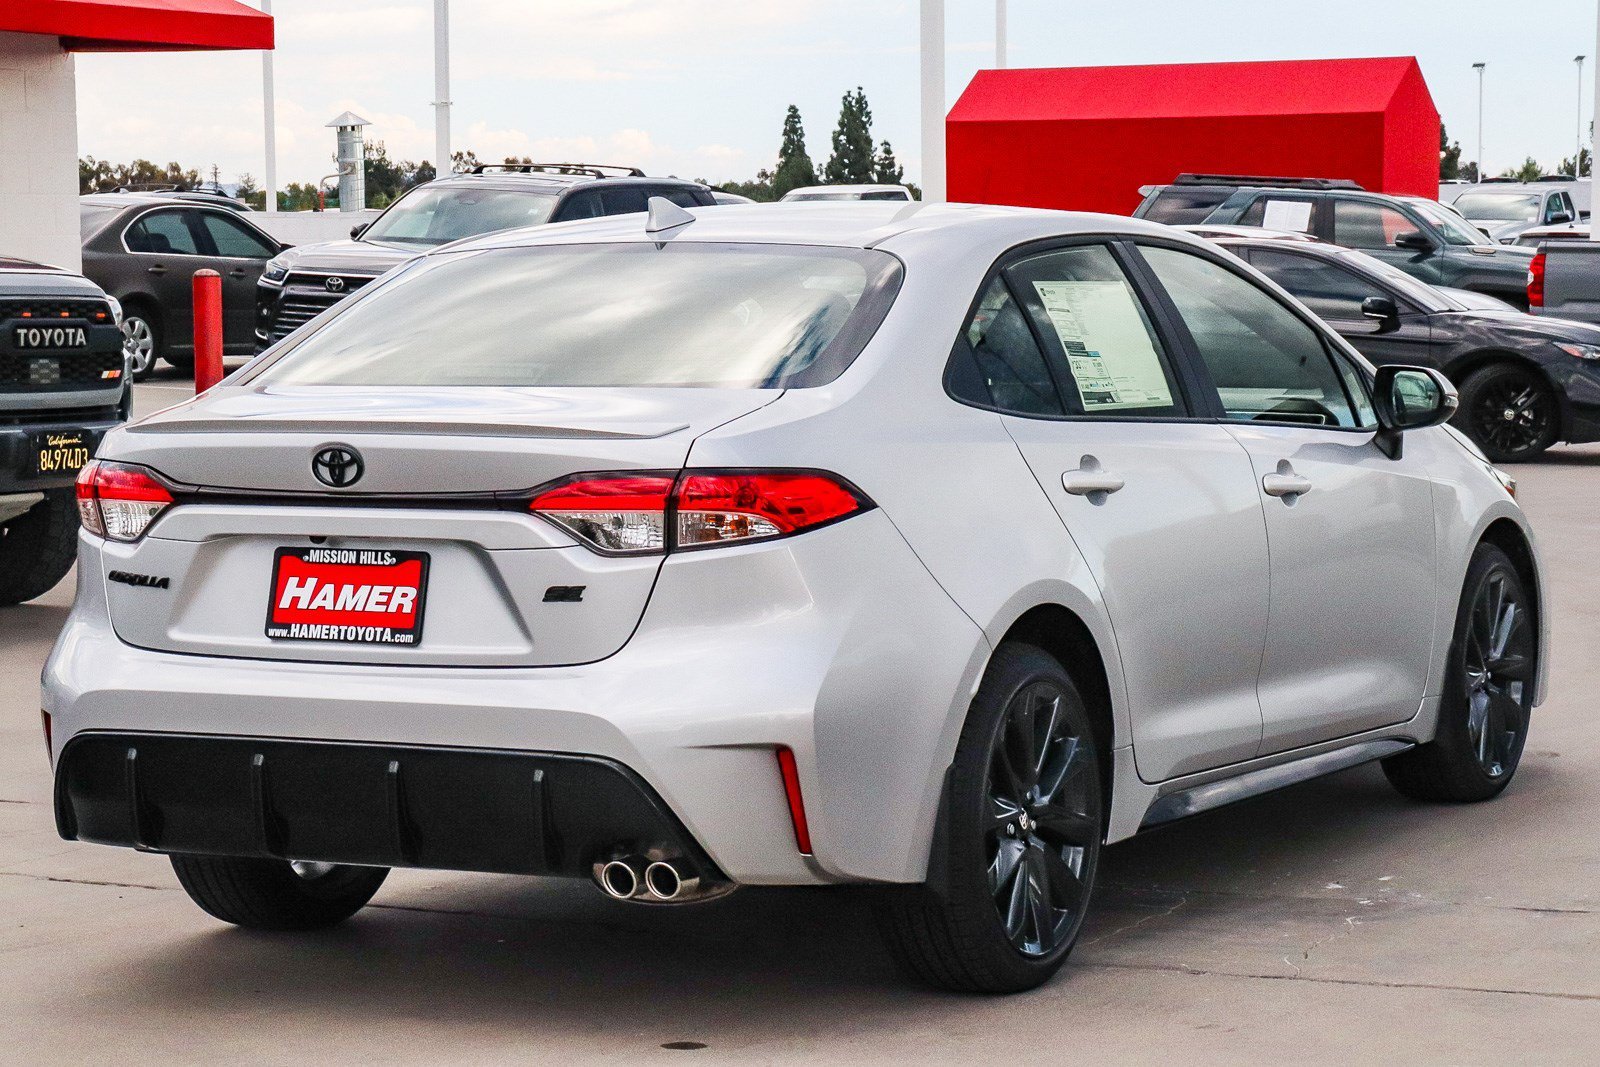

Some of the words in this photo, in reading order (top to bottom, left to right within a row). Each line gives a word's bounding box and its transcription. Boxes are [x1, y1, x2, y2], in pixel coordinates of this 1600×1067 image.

[17, 328, 87, 346] TOYOTA
[40, 447, 88, 471] 84974D3
[309, 550, 356, 563] MISSION
[360, 551, 392, 565] HILLS
[279, 577, 417, 613] HAMER
[268, 624, 413, 643] www.HAMERTOYOTA.com
